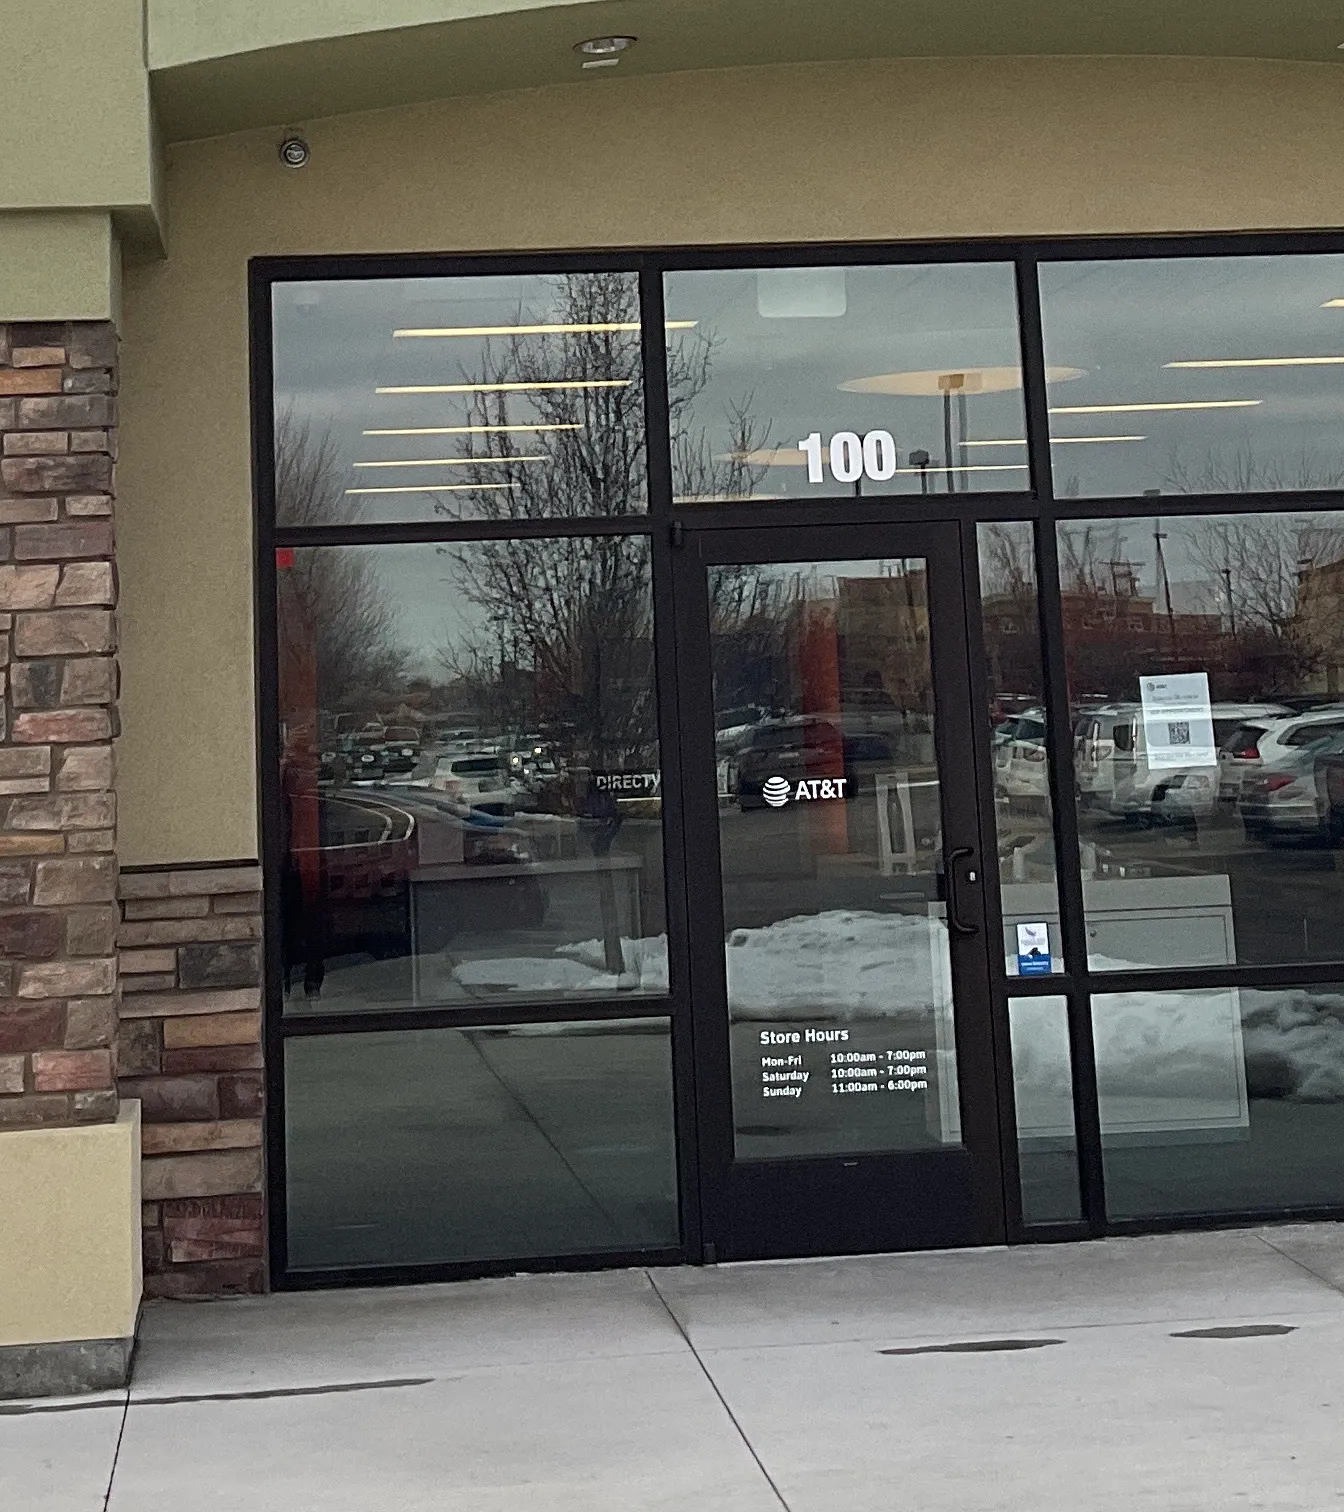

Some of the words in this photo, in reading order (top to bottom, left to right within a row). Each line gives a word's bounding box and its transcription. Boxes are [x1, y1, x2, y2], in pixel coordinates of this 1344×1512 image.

[798, 430, 896, 484] 100
[795, 778, 847, 800] AT&T
[760, 1030, 800, 1045] Store
[805, 1028, 849, 1043] Hours
[761, 1055, 803, 1067] Mon-Fri
[830, 1052, 876, 1064] 10:00am
[886, 1050, 926, 1062] 7:00pm
[762, 1070, 809, 1083] Saturday
[831, 1067, 877, 1079] 10:00am
[887, 1065, 927, 1077] 7:00pm
[763, 1085, 802, 1098] Sunday
[832, 1082, 878, 1094] 11:00am
[887, 1079, 928, 1091] 6:00pm
